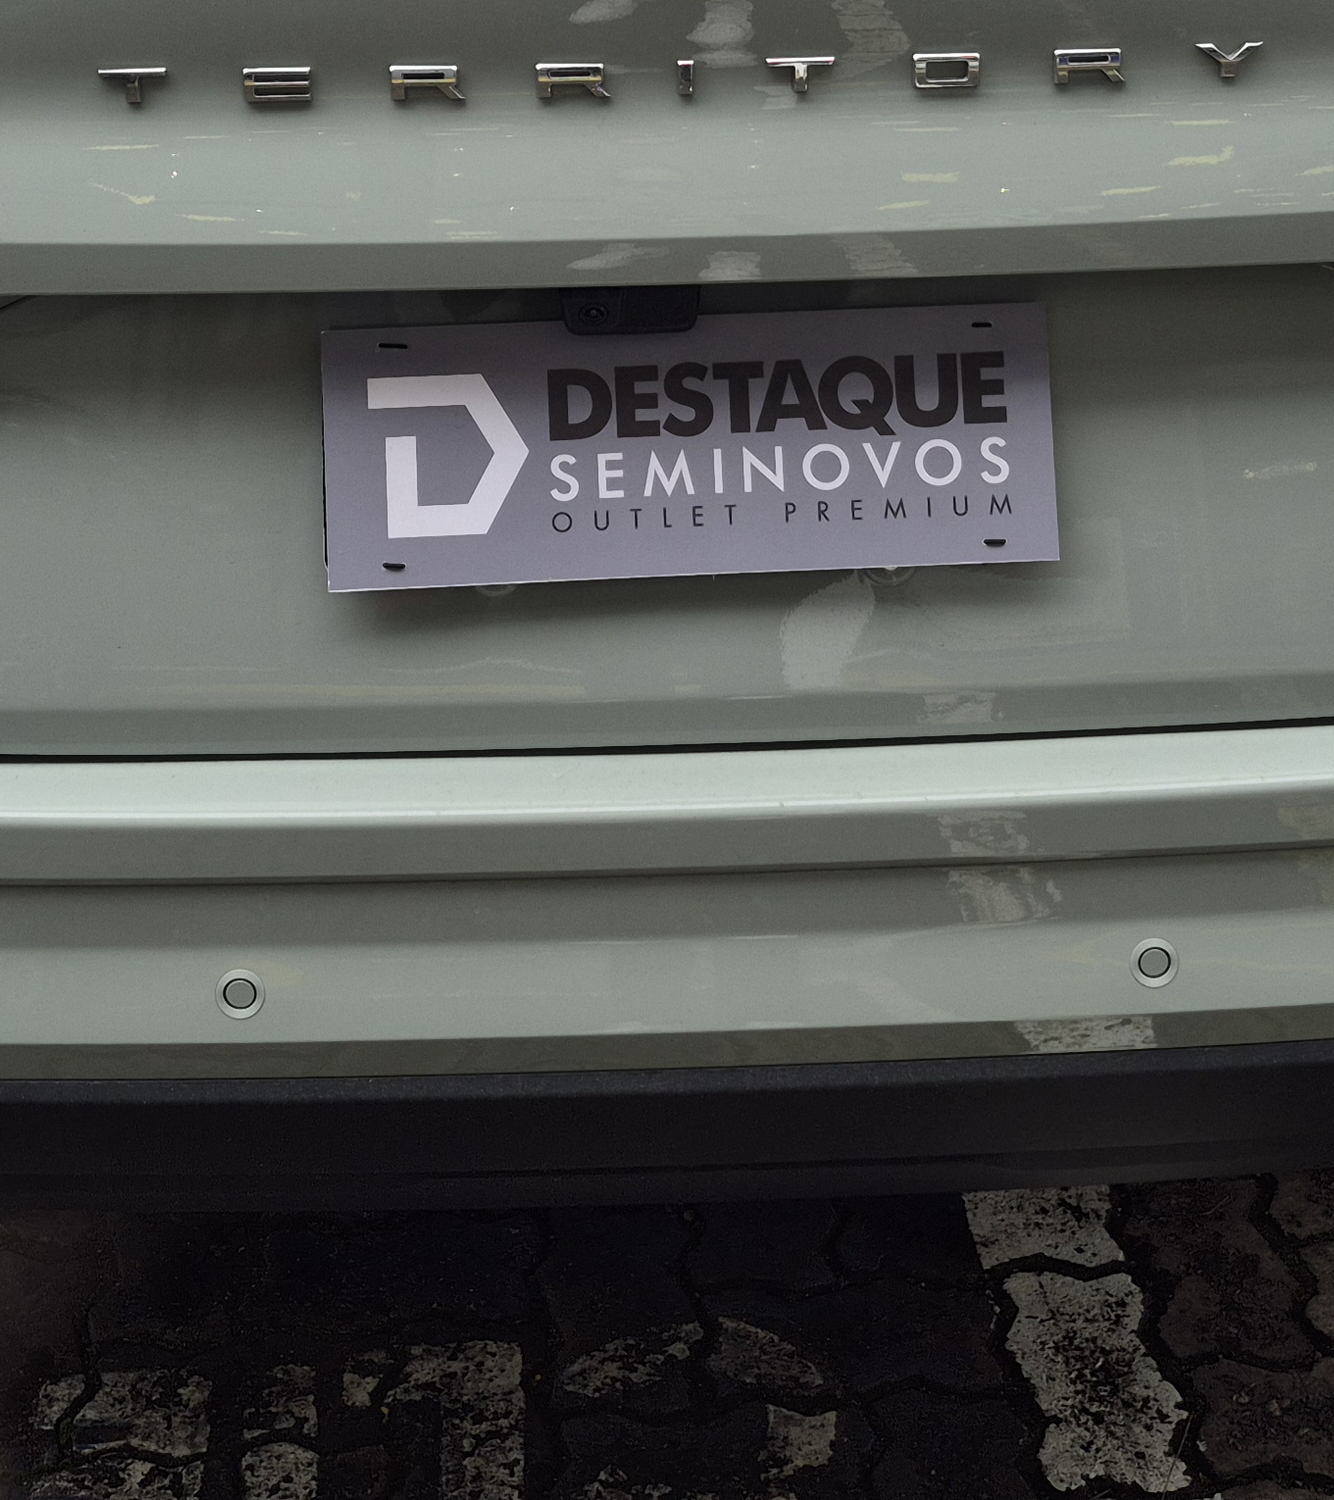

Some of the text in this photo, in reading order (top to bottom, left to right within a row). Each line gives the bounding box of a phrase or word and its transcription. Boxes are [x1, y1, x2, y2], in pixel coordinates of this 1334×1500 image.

[97, 40, 1264, 104] TERRITORY
[546, 350, 1009, 442] DESTAQUE
[550, 436, 1011, 503] SEMINOVOS
[551, 493, 1015, 534] OUTLET PREMIUM
